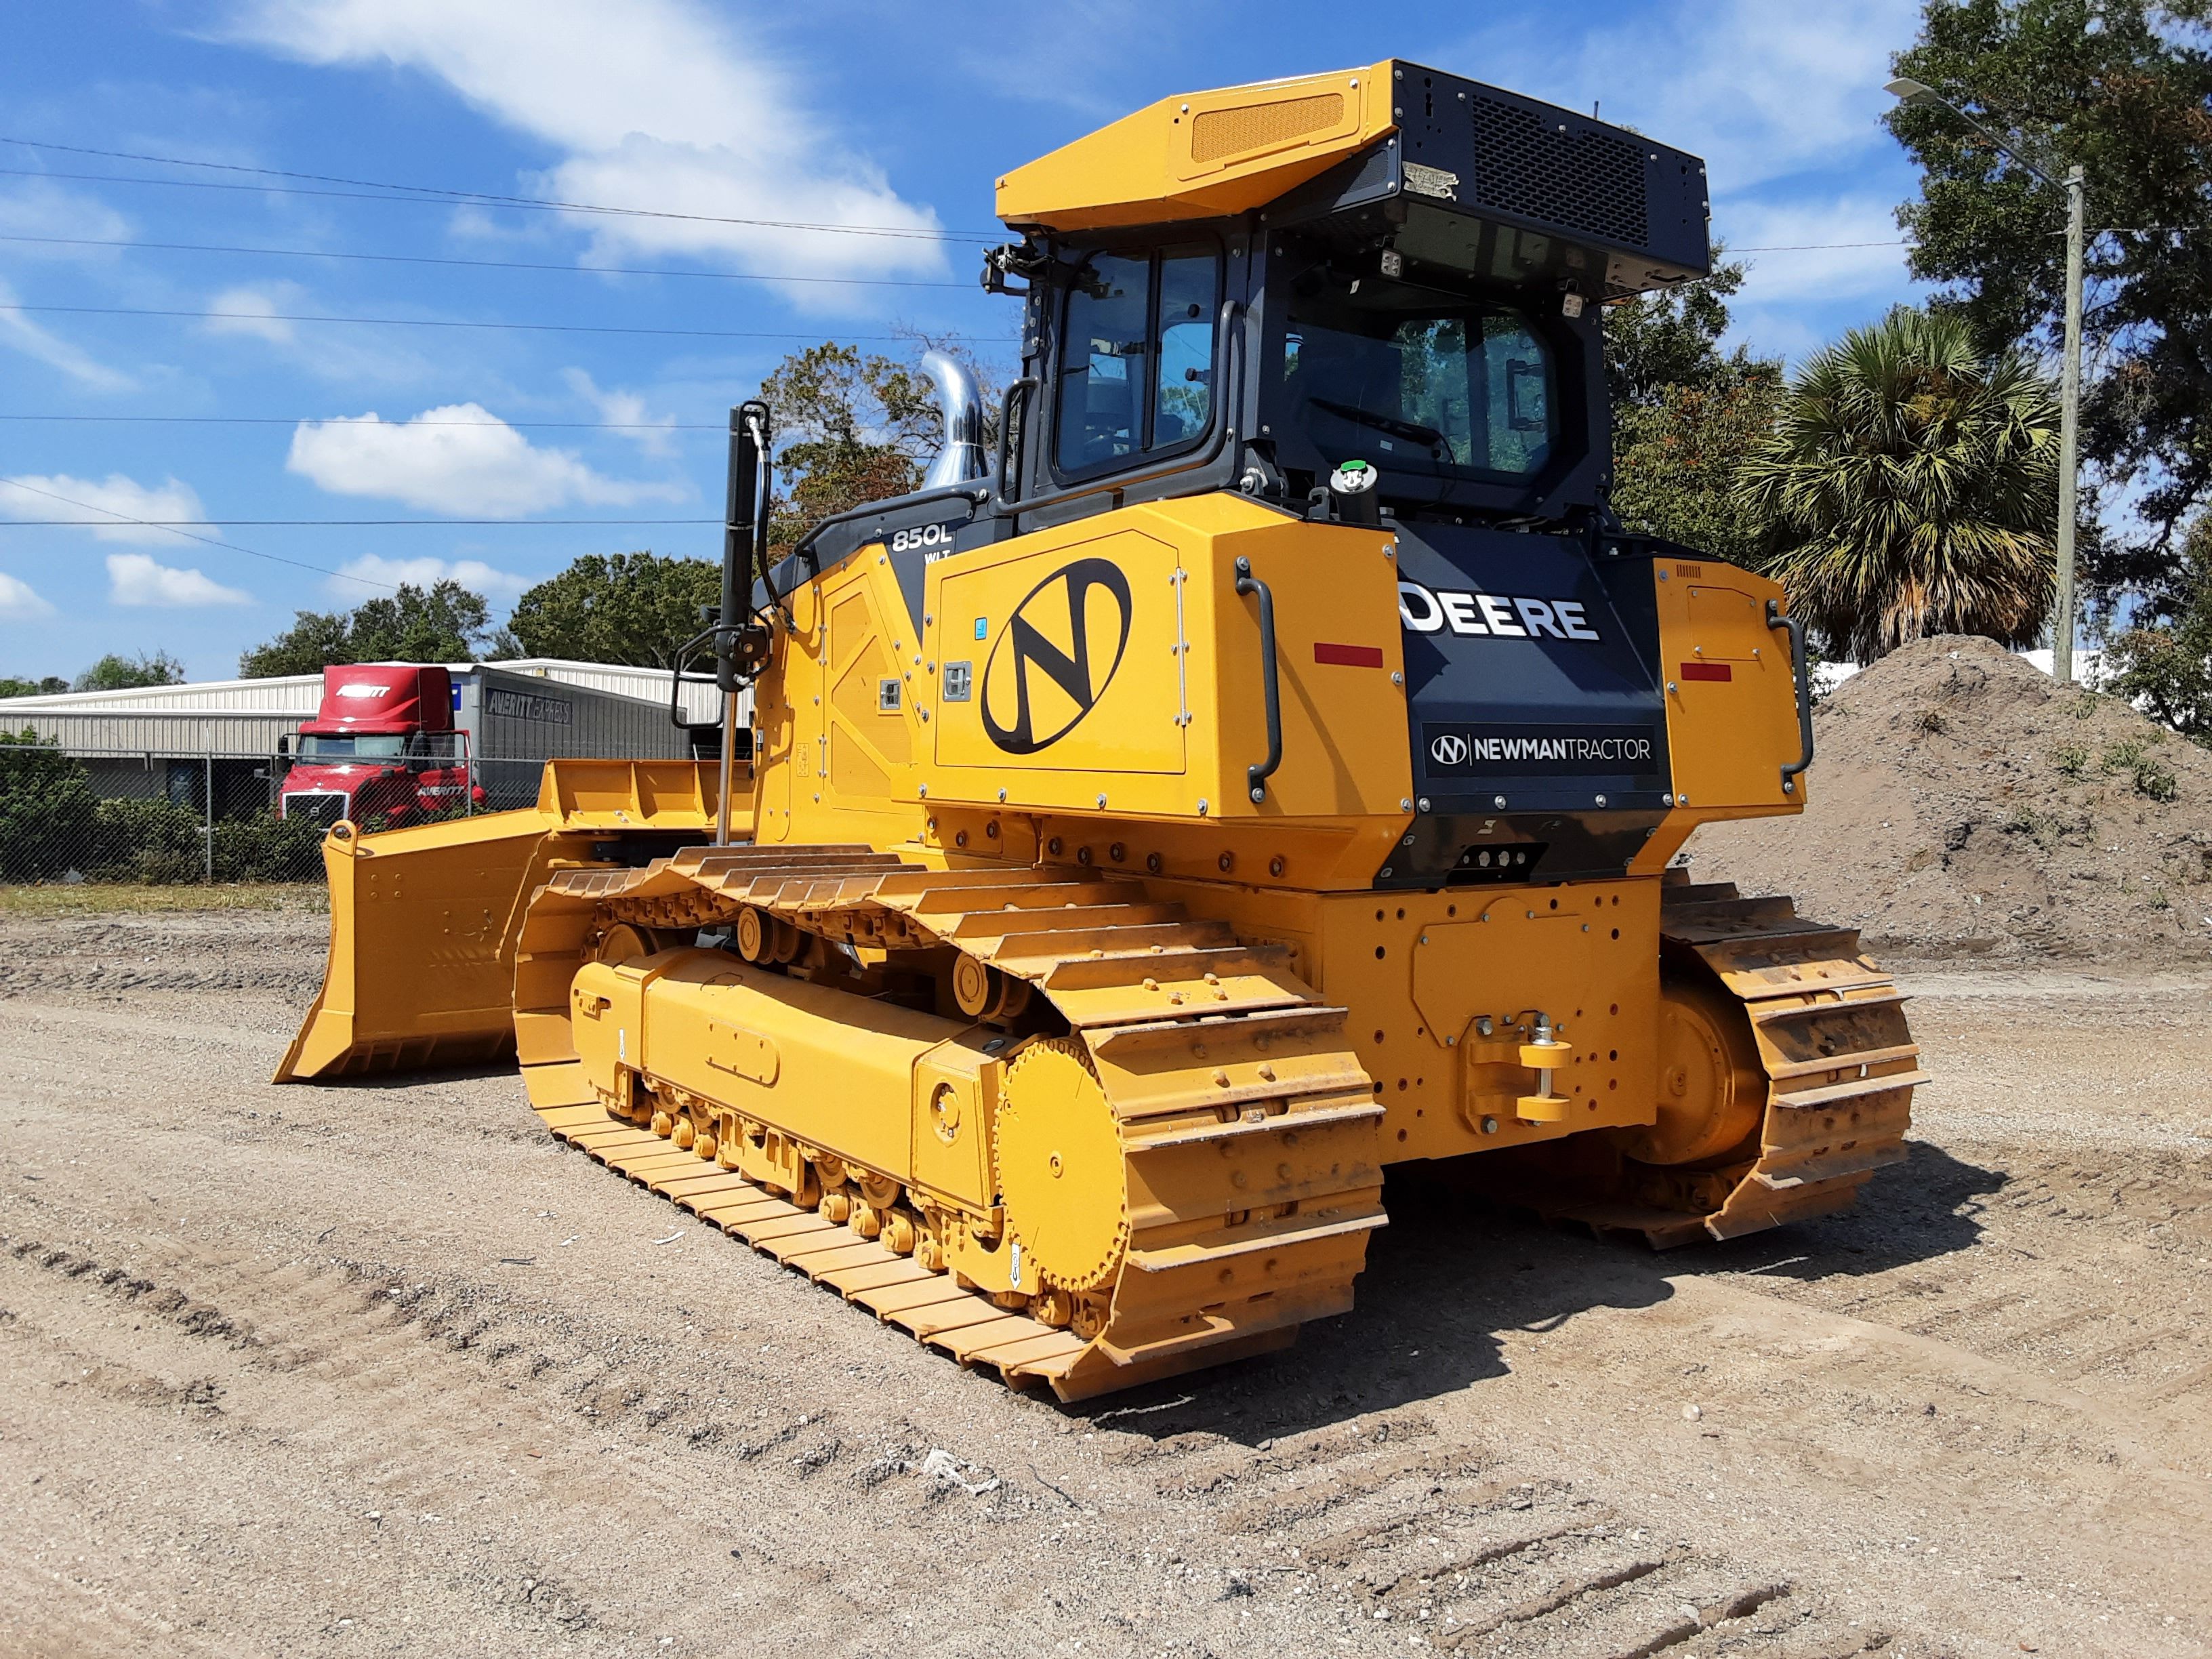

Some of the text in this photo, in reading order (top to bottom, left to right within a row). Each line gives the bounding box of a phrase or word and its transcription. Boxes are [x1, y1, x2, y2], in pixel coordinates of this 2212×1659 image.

[892, 524, 952, 552] 850L
[1397, 581, 1600, 640] DEERE
[335, 684, 391, 698] AITT
[489, 691, 533, 718] AVERITT
[417, 786, 465, 796] AVERITT
